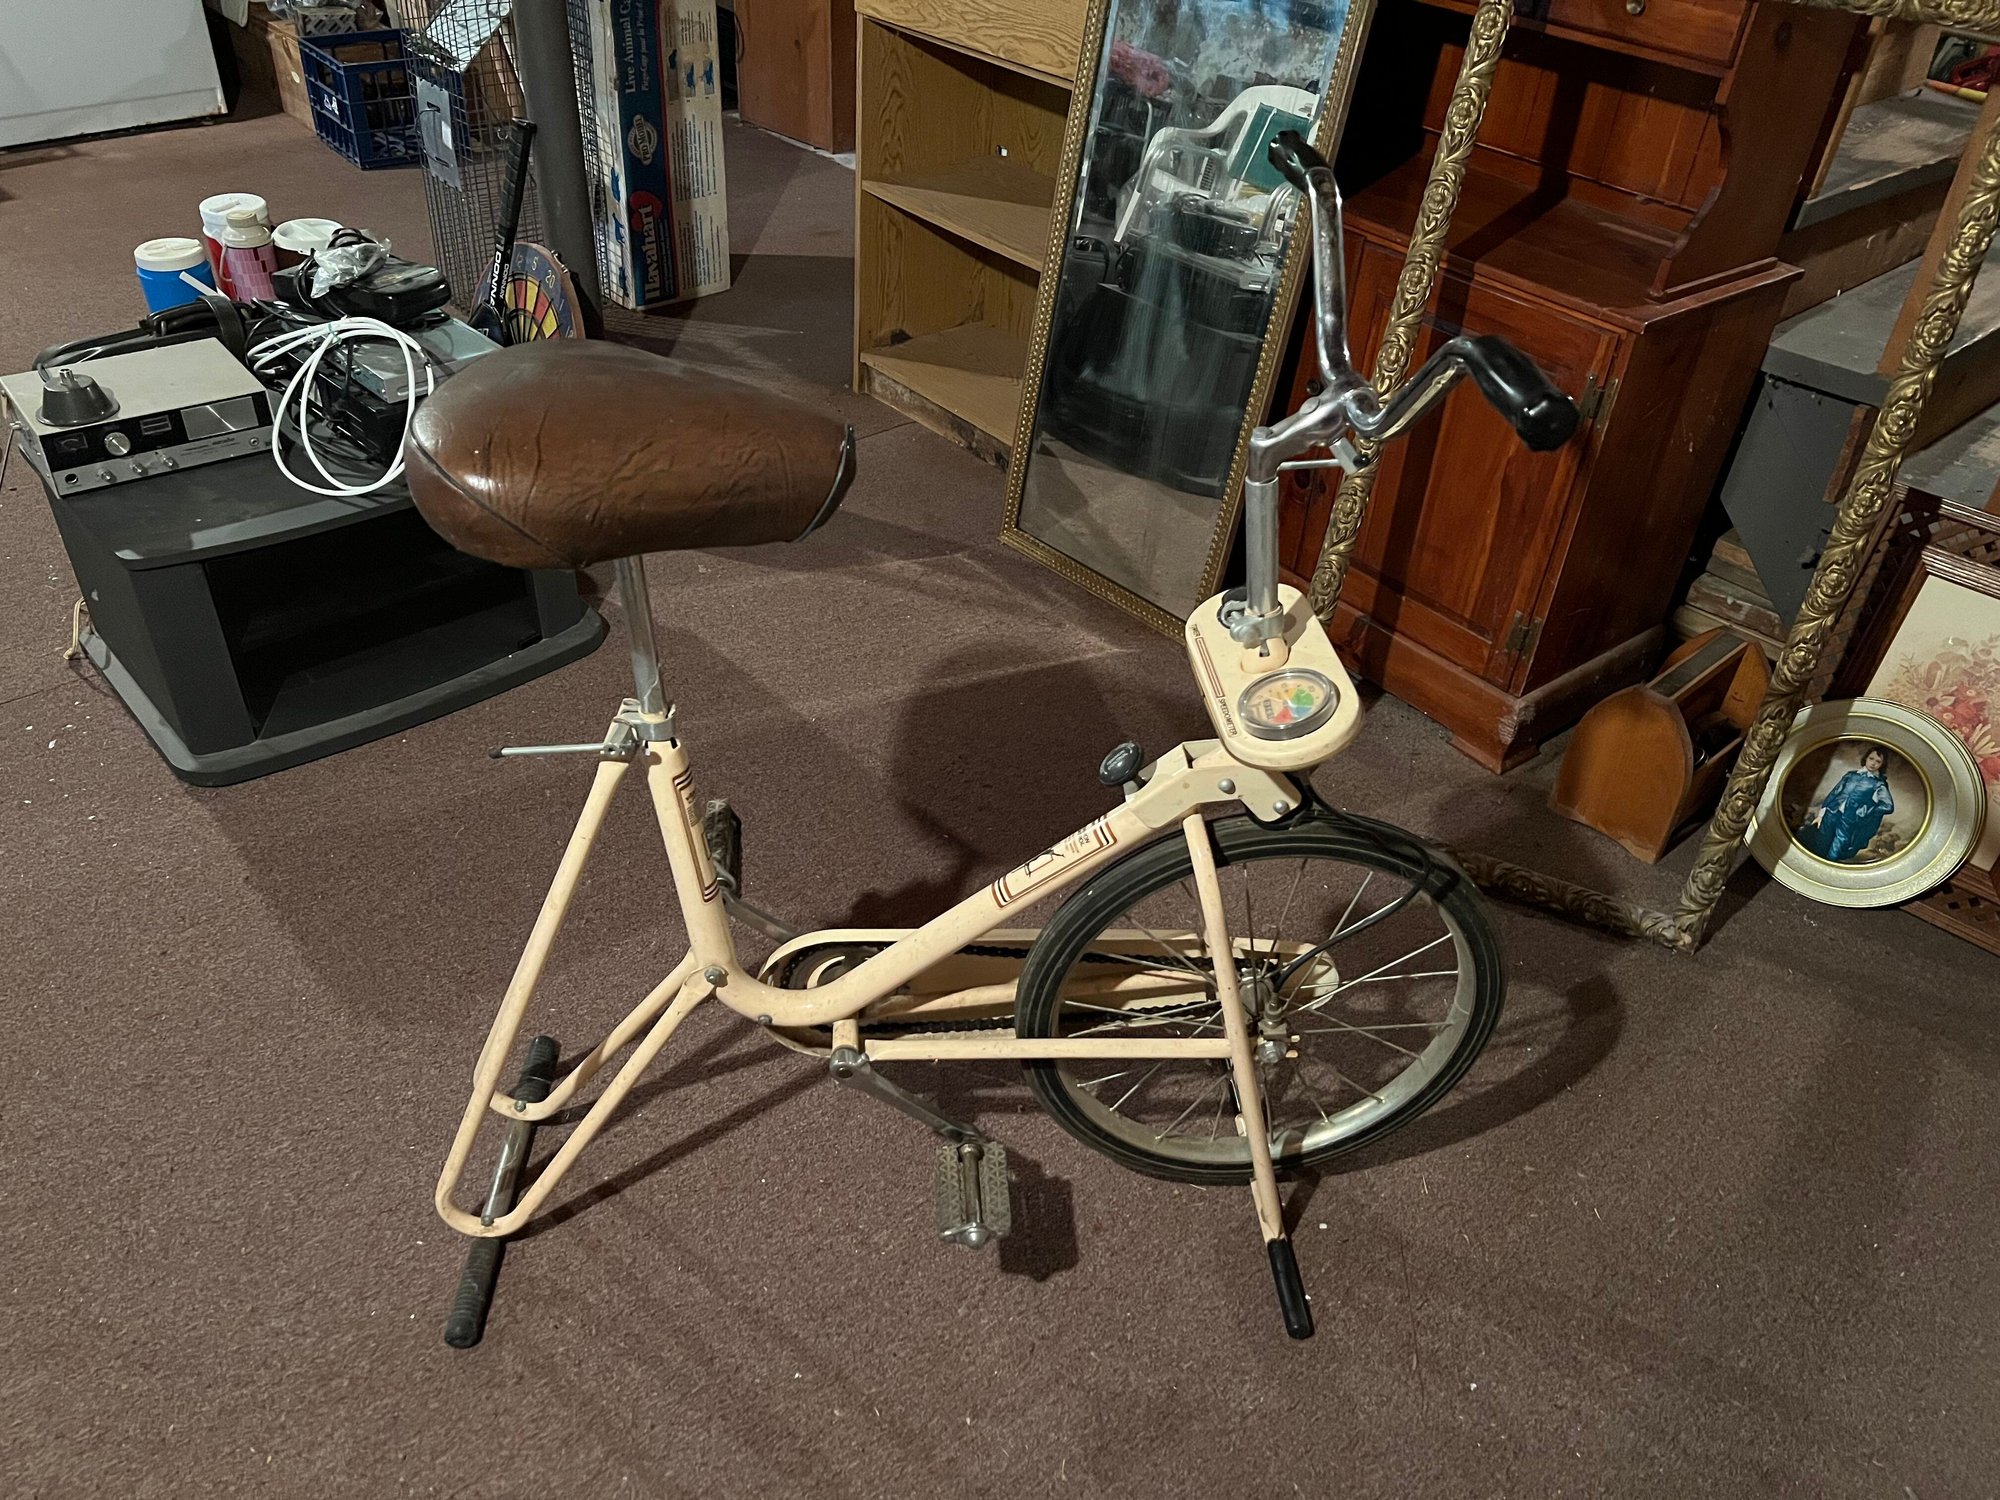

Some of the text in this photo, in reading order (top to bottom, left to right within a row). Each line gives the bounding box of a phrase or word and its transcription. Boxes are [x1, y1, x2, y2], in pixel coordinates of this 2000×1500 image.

[619, 16, 634, 63] Animal
[624, 66, 636, 94] Live
[640, 143, 651, 161] PRO
[531, 256, 539, 271] 5
[638, 205, 660, 302] Havahart
[500, 263, 510, 299] DONNAY
[545, 269, 556, 289] 20
[1218, 697, 1238, 737] SPEEDOMETER
